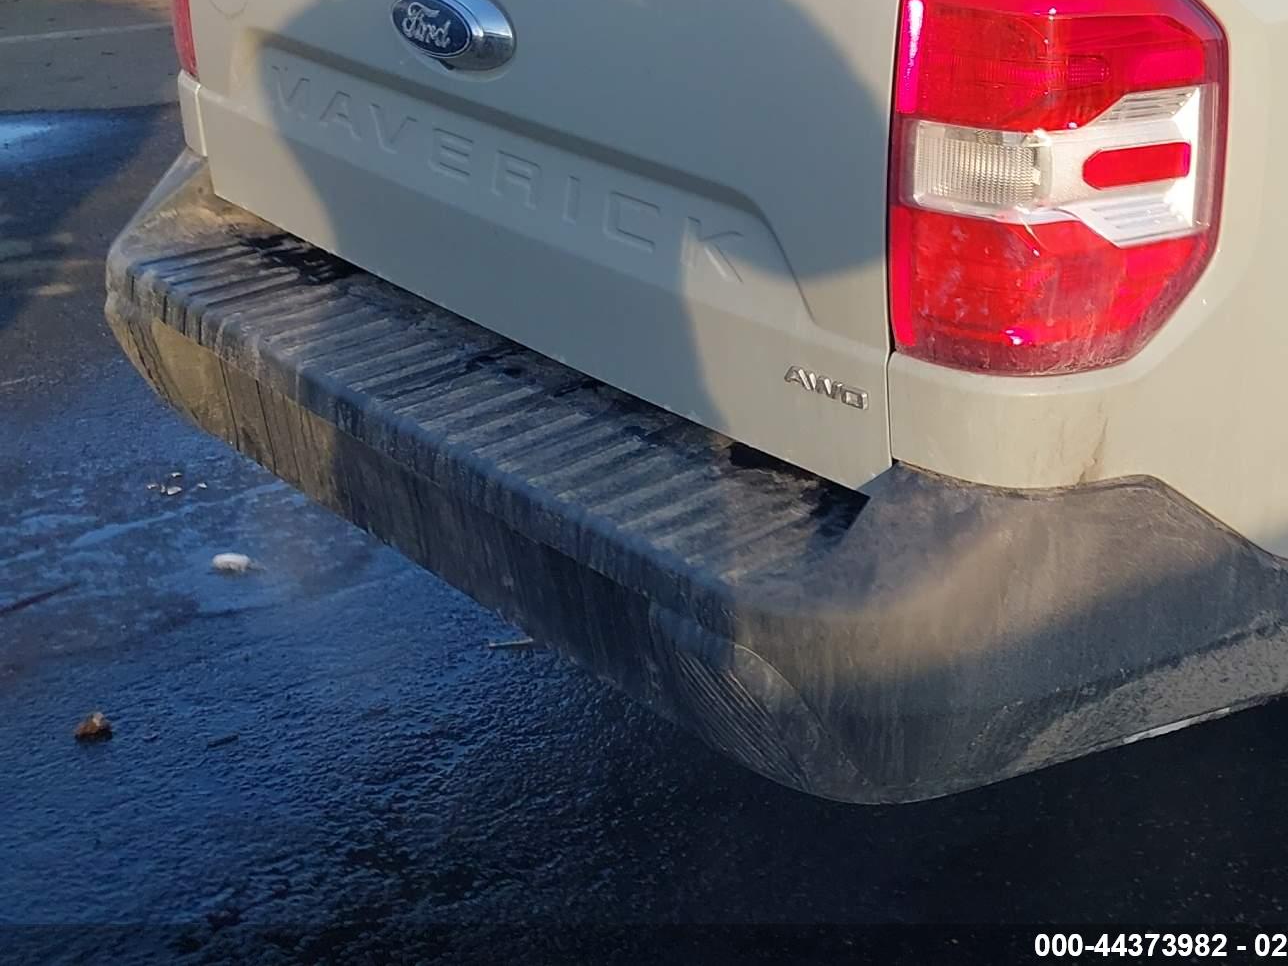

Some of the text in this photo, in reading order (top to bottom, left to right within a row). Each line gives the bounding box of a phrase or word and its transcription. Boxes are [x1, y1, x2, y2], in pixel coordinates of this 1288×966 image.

[402, 1, 451, 48] Ford
[271, 65, 745, 284] MAVERICK
[784, 365, 869, 411] AWD
